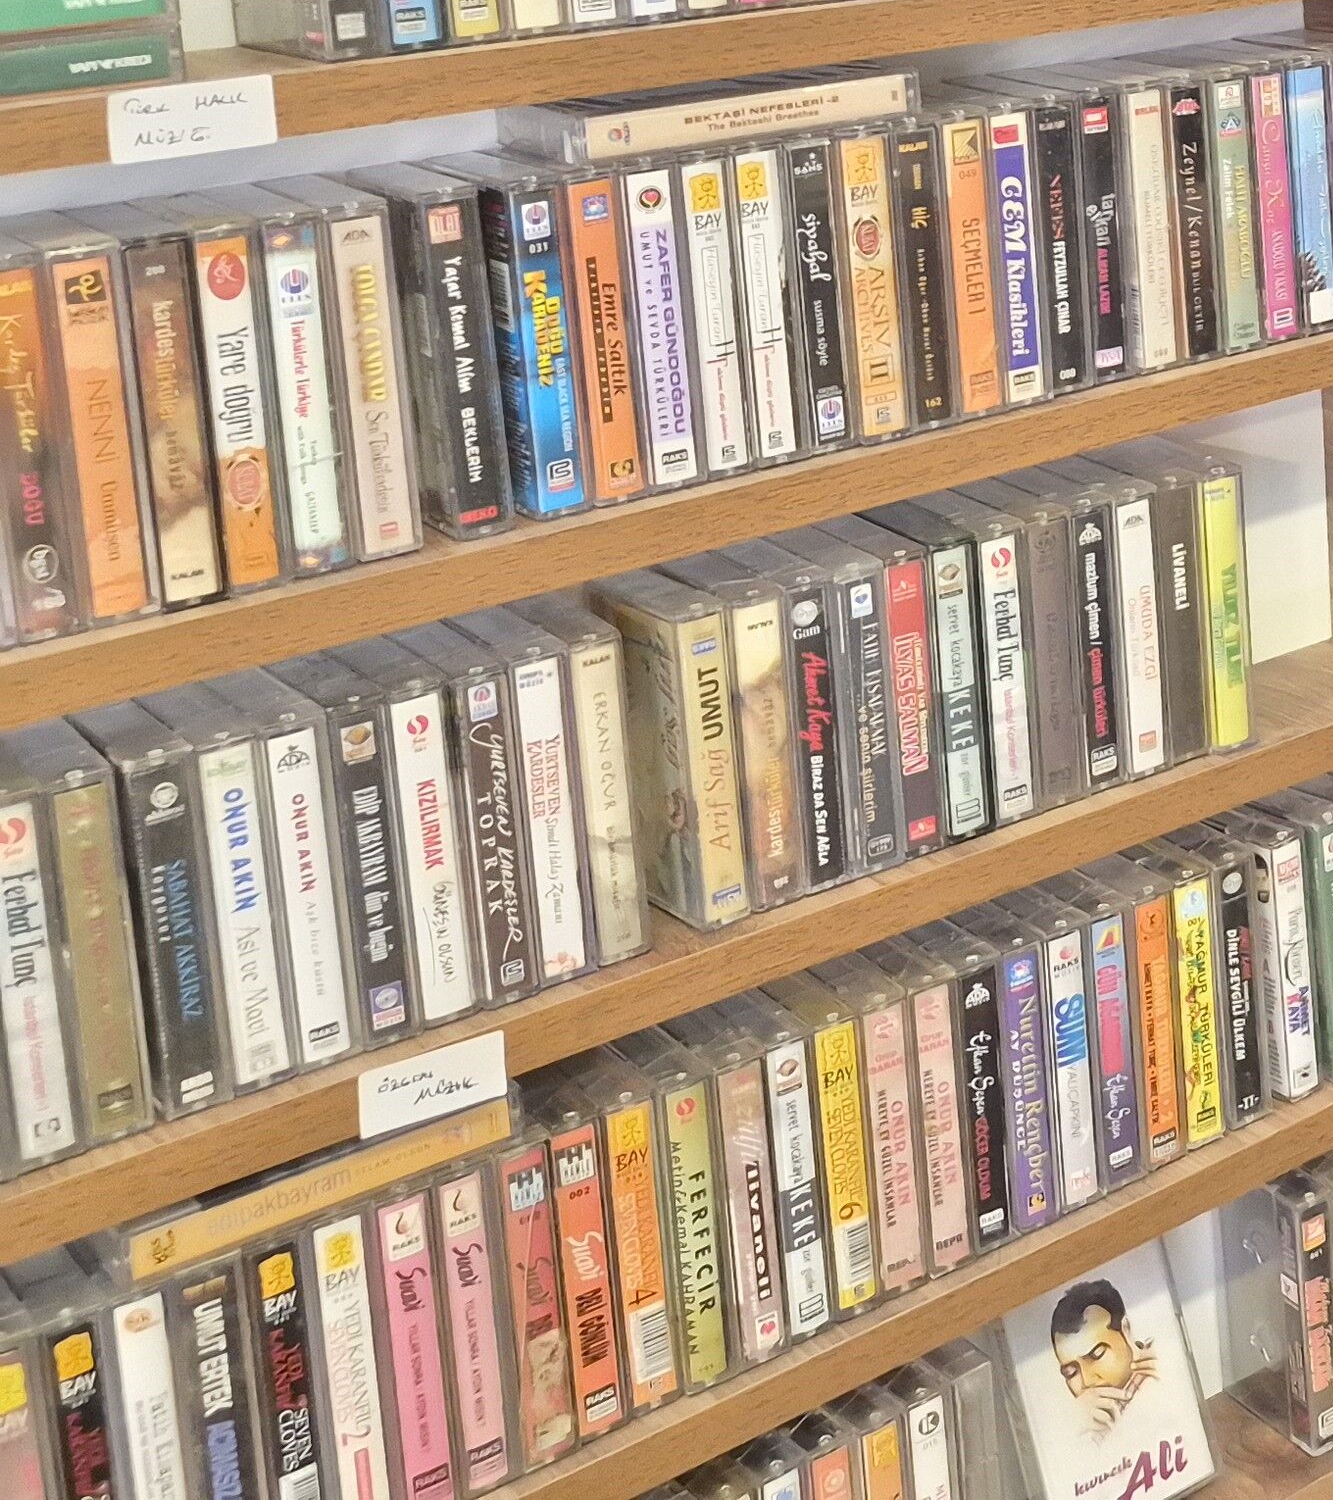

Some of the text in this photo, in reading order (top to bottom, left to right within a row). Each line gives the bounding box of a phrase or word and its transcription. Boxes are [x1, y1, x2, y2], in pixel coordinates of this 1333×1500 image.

[1220, 158, 1234, 188] Zalim
[446, 304, 470, 351] Kemal
[600, 281, 628, 396] Emre Saltık
[639, 230, 670, 437] UMUT ve SEVDA TÜRKÜLERİ
[654, 227, 687, 435] ZAFER GÜNDOĞDU
[1003, 257, 1033, 358] Klasikleri
[214, 325, 257, 447] Yare doğru
[1168, 541, 1192, 611] LİVANELİ
[590, 690, 612, 755] ERKAN
[945, 688, 977, 749] KEKE
[541, 733, 566, 817] YURTSEVEN
[219, 786, 253, 851] ONUR
[415, 777, 445, 871] KIZILIRMAK
[224, 856, 262, 915] AKIN
[475, 791, 503, 917] TOPRAK
[240, 987, 273, 1039] Mavi
[1012, 995, 1046, 1095] Nurettin
[1284, 994, 1302, 1034] KAYA
[615, 1147, 650, 1173] BAY
[684, 1169, 722, 1315] FERFECİR
[276, 1409, 298, 1473] CLOVES
[293, 1407, 313, 1460] SEVEN
